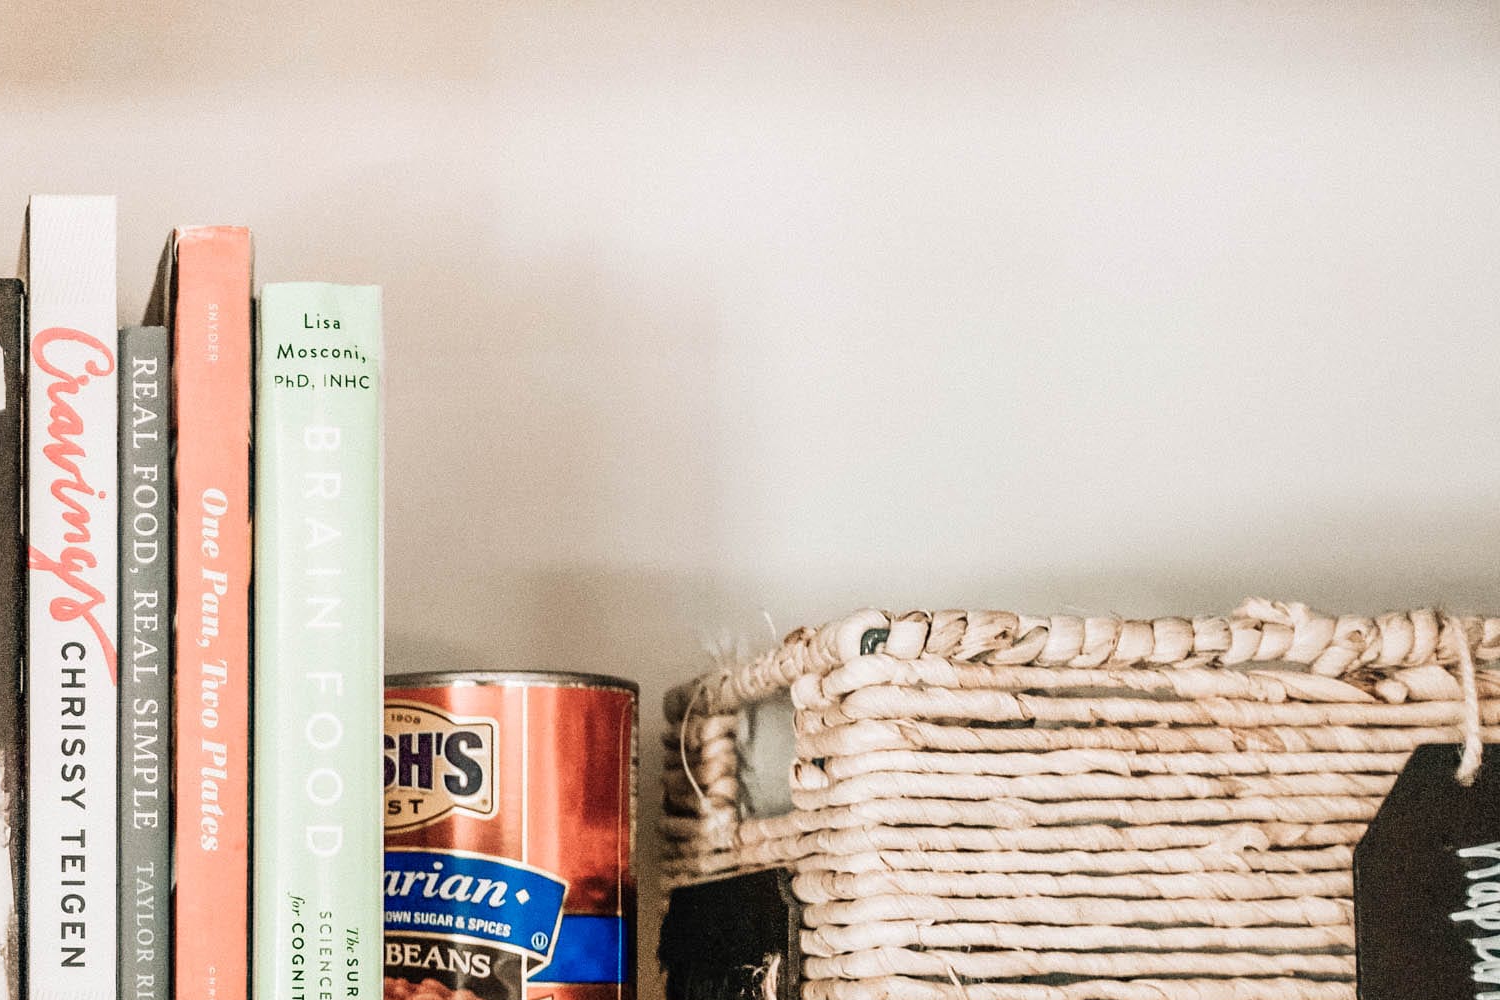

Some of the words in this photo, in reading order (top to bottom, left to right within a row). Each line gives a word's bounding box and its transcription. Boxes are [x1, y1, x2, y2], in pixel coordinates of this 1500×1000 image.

[208, 303, 219, 361] SNYDER
[277, 343, 367, 364] Mosconi,
[304, 313, 341, 330] Lisa
[132, 357, 159, 448] REAL
[275, 375, 315, 390] PhD,
[324, 375, 371, 390] INHC
[28, 327, 117, 686] Cravings
[128, 464, 159, 574] FOOD,
[201, 488, 228, 558] One
[303, 426, 342, 628] BRAIN
[132, 589, 159, 682] REAL
[197, 568, 228, 649] Pan,
[61, 641, 86, 810] CHRISSY
[202, 657, 228, 727] Two
[133, 698, 159, 829] SIMPLE
[200, 738, 229, 852] Plates
[305, 671, 344, 858] FOOD
[61, 829, 86, 969] TEIGEN
[136, 862, 155, 962] TAYLOR
[288, 891, 306, 917] for
[345, 928, 359, 953] The
[413, 911, 453, 928] SUGAR
[455, 916, 465, 929] &
[468, 918, 512, 938] SPICES
[319, 911, 332, 1000] SCIENCE
[385, 943, 491, 979] BEANS
